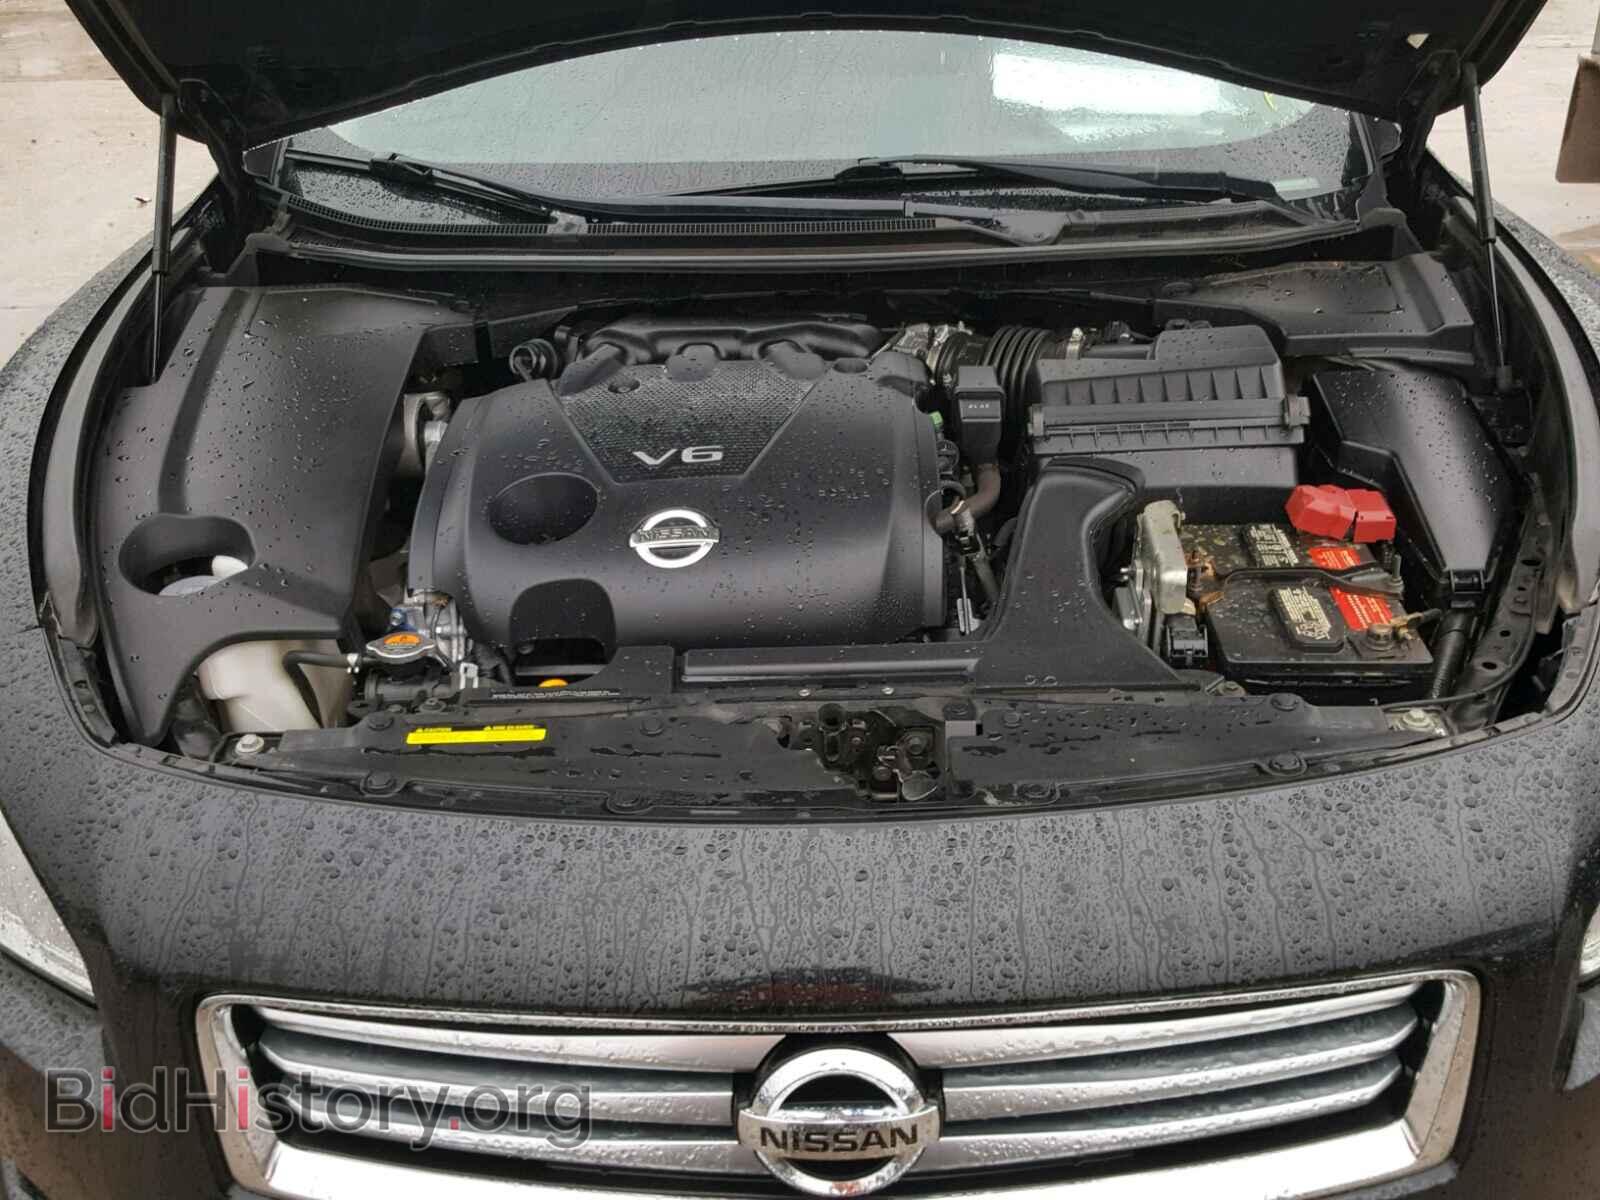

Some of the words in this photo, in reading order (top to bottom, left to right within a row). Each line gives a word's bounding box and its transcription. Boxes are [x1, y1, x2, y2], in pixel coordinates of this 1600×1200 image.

[633, 445, 724, 465] V6
[640, 527, 713, 540] NISSAN
[760, 1124, 917, 1152] NISSAN
